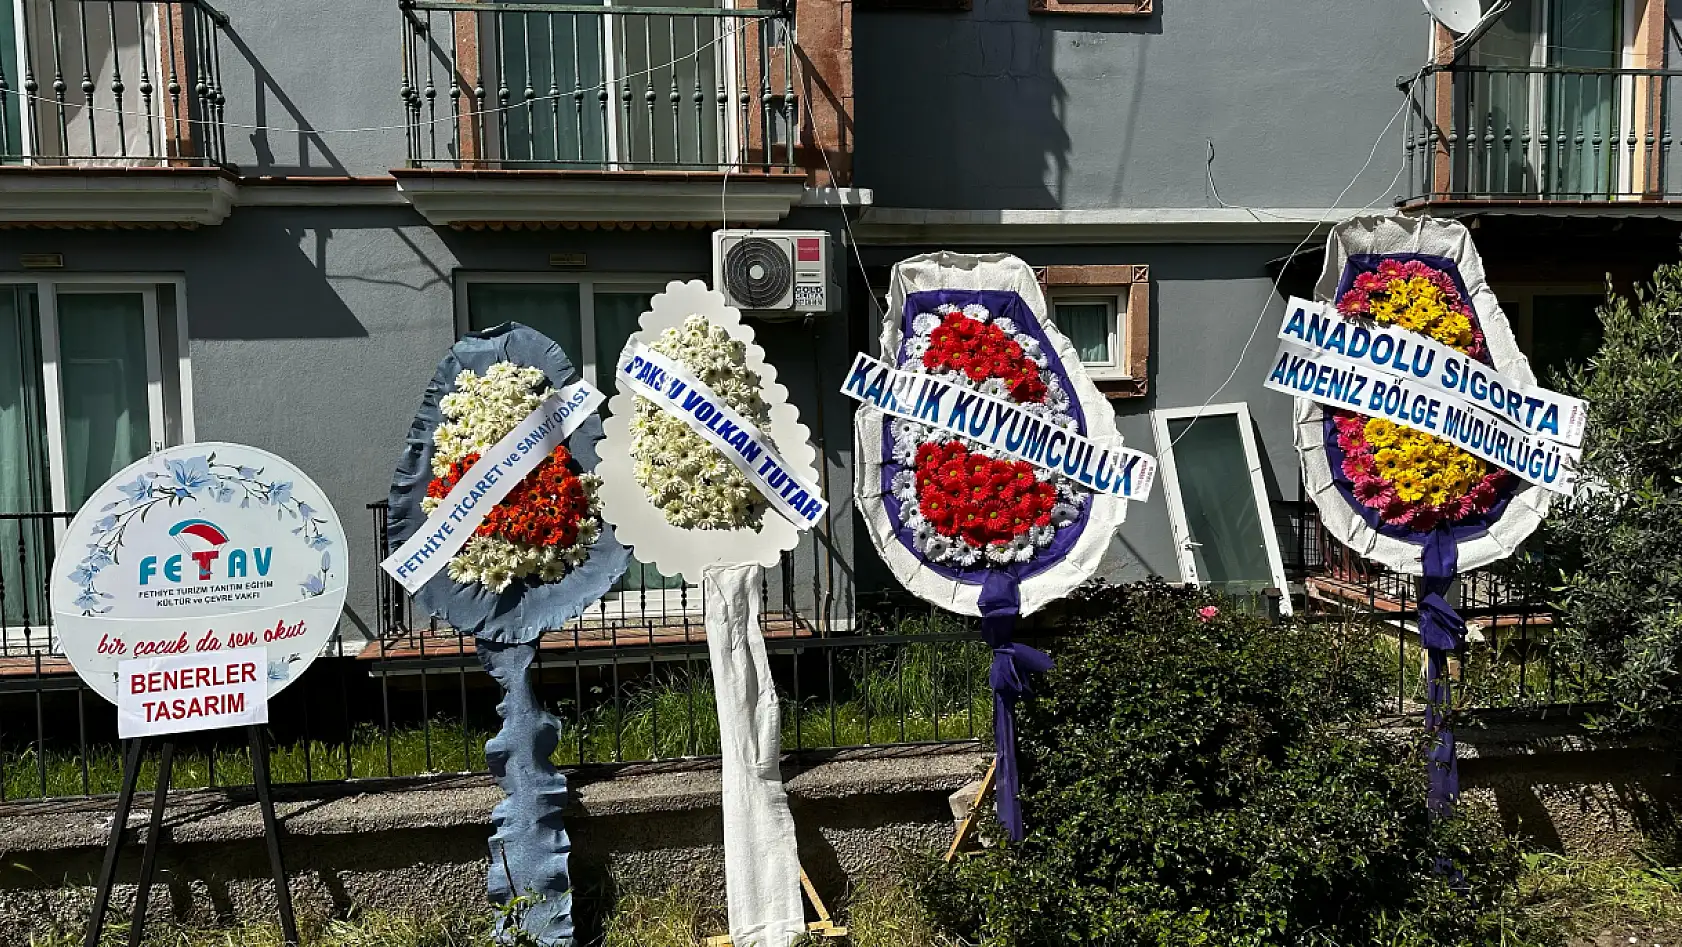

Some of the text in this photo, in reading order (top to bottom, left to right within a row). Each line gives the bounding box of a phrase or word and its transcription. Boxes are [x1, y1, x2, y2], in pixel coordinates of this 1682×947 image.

[1283, 307, 1436, 378] ANADOLU
[1441, 357, 1559, 436] SİGORTA
[1269, 351, 1368, 407] AKDENİZ
[1368, 378, 1441, 430] BÖLGE
[1442, 405, 1562, 484] MÜDÜRLÜĞÜ
[681, 390, 763, 464] VOLKAN
[757, 455, 823, 521] TUTAR
[946, 390, 1142, 497] KUYUMCULUK
[396, 387, 591, 579] FETHİYE TİCARET ve SANAYİ ODASI
[139, 546, 273, 586] FETAV
[157, 597, 191, 607] KÜLTÜR
[204, 594, 233, 605] ÇEVRE
[234, 591, 261, 600] VAKFI
[176, 583, 208, 596] TURİZM
[210, 582, 243, 593] TANITIM
[245, 580, 273, 590] EĞİTİM
[97, 619, 308, 658] bir çocuk da sen okut
[130, 661, 257, 694] BENERLER
[142, 692, 245, 723] TASARIM
